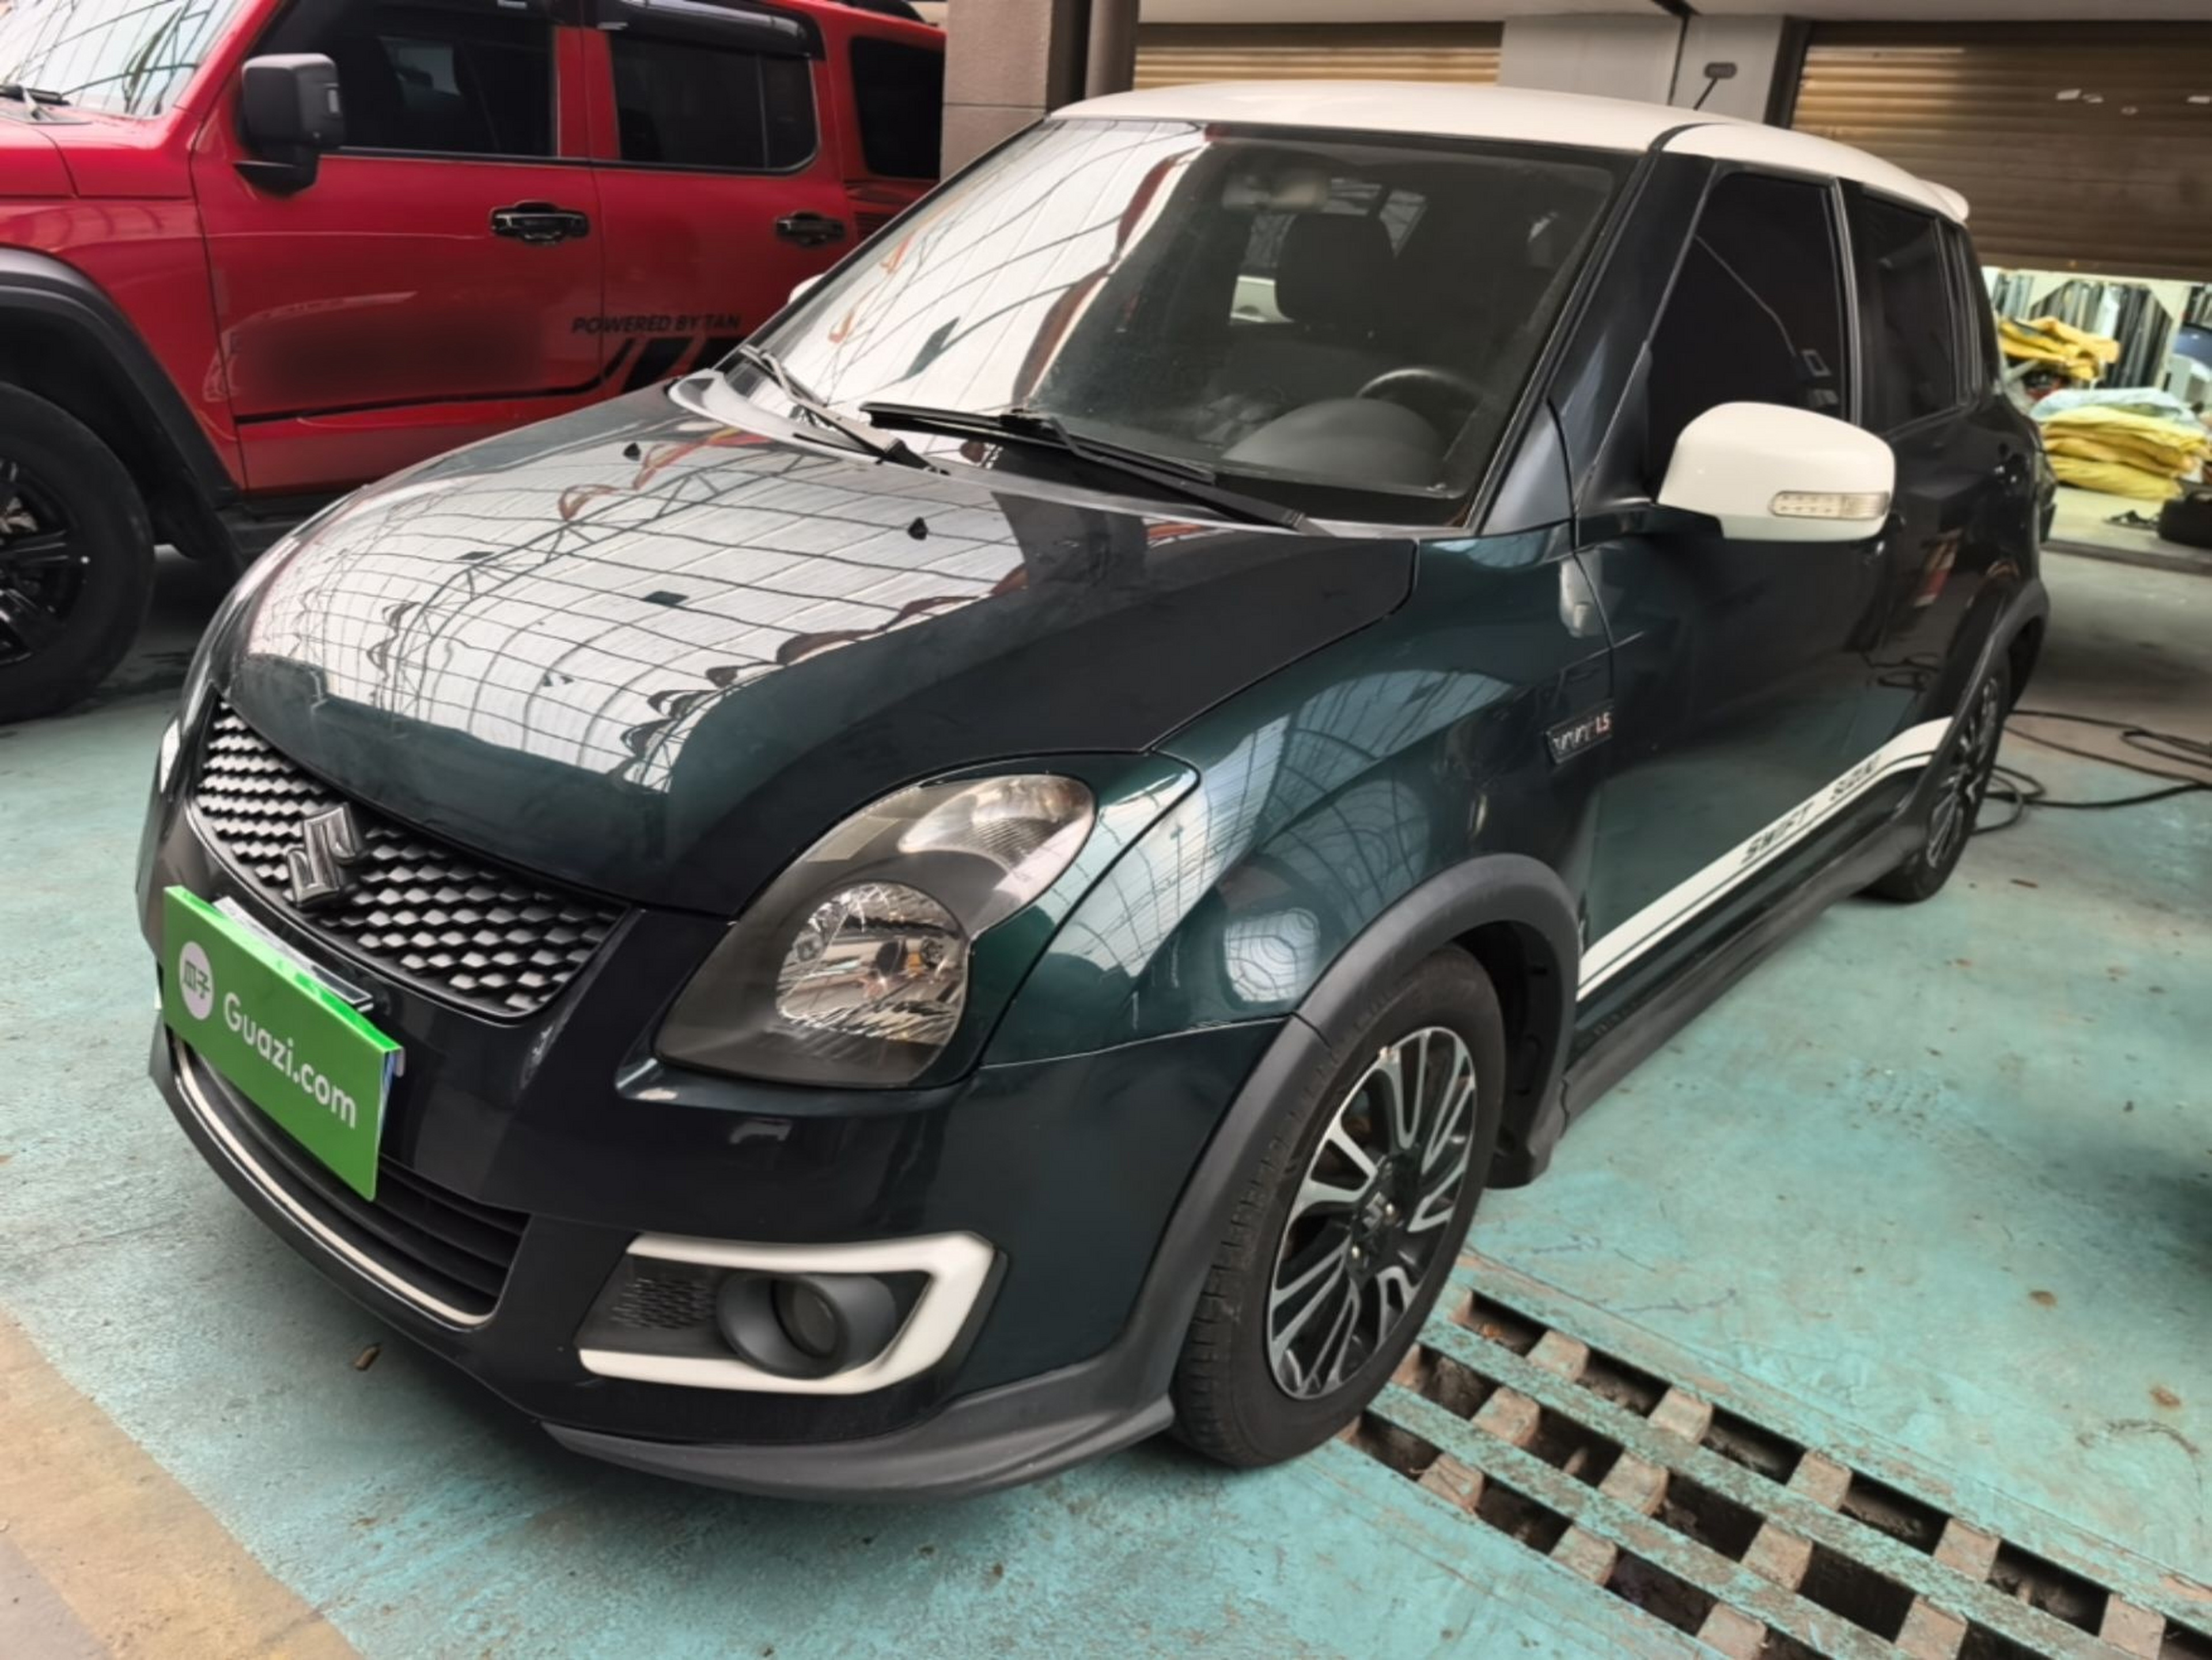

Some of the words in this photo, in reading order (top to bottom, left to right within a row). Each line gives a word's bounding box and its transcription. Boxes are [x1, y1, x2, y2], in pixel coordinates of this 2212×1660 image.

[572, 316, 669, 334] POWERED
[675, 315, 699, 331] BY
[223, 991, 357, 1129] Guazi.com
